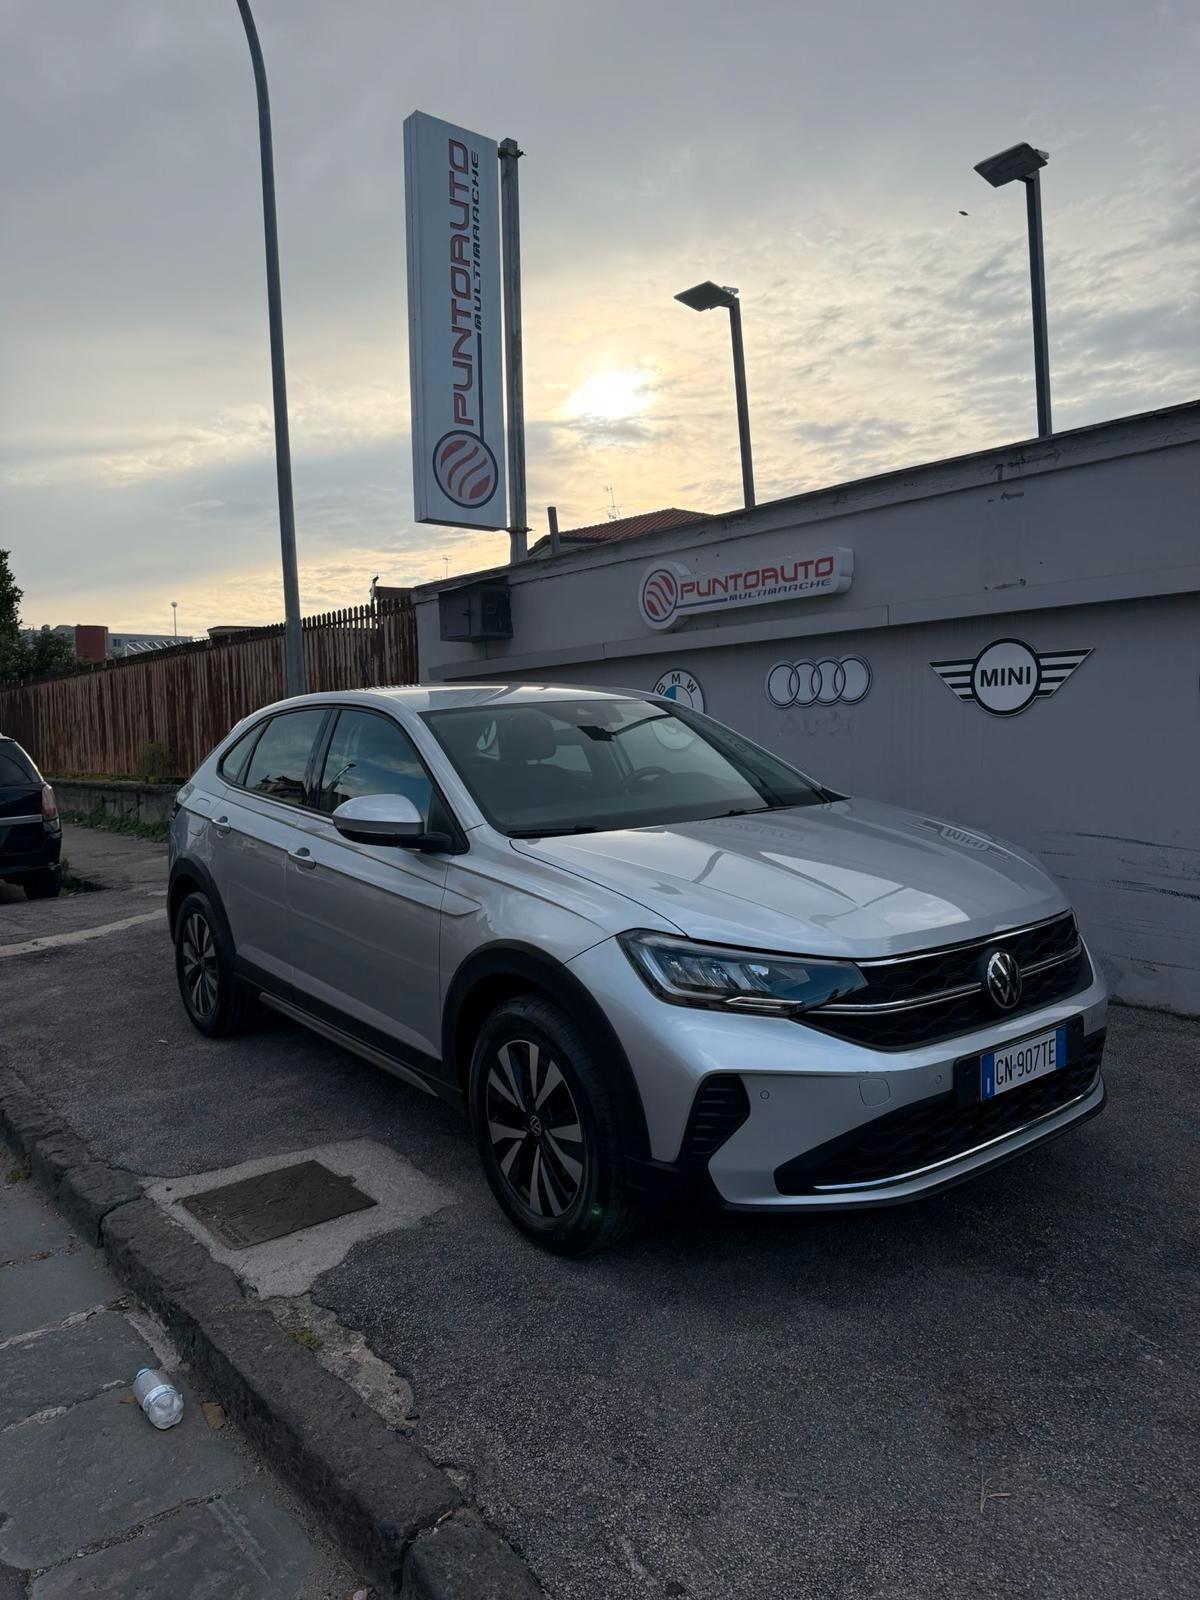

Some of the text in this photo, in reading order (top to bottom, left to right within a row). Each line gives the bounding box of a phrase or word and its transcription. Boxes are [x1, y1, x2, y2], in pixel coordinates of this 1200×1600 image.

[472, 151, 482, 330] MULTIMARCHE
[448, 137, 474, 426] PUNTOAUTO
[680, 556, 834, 600] PUNTOAUTO
[729, 578, 832, 601] MULTIMARCHE
[656, 672, 697, 695] BMW
[979, 666, 1032, 688] MINI
